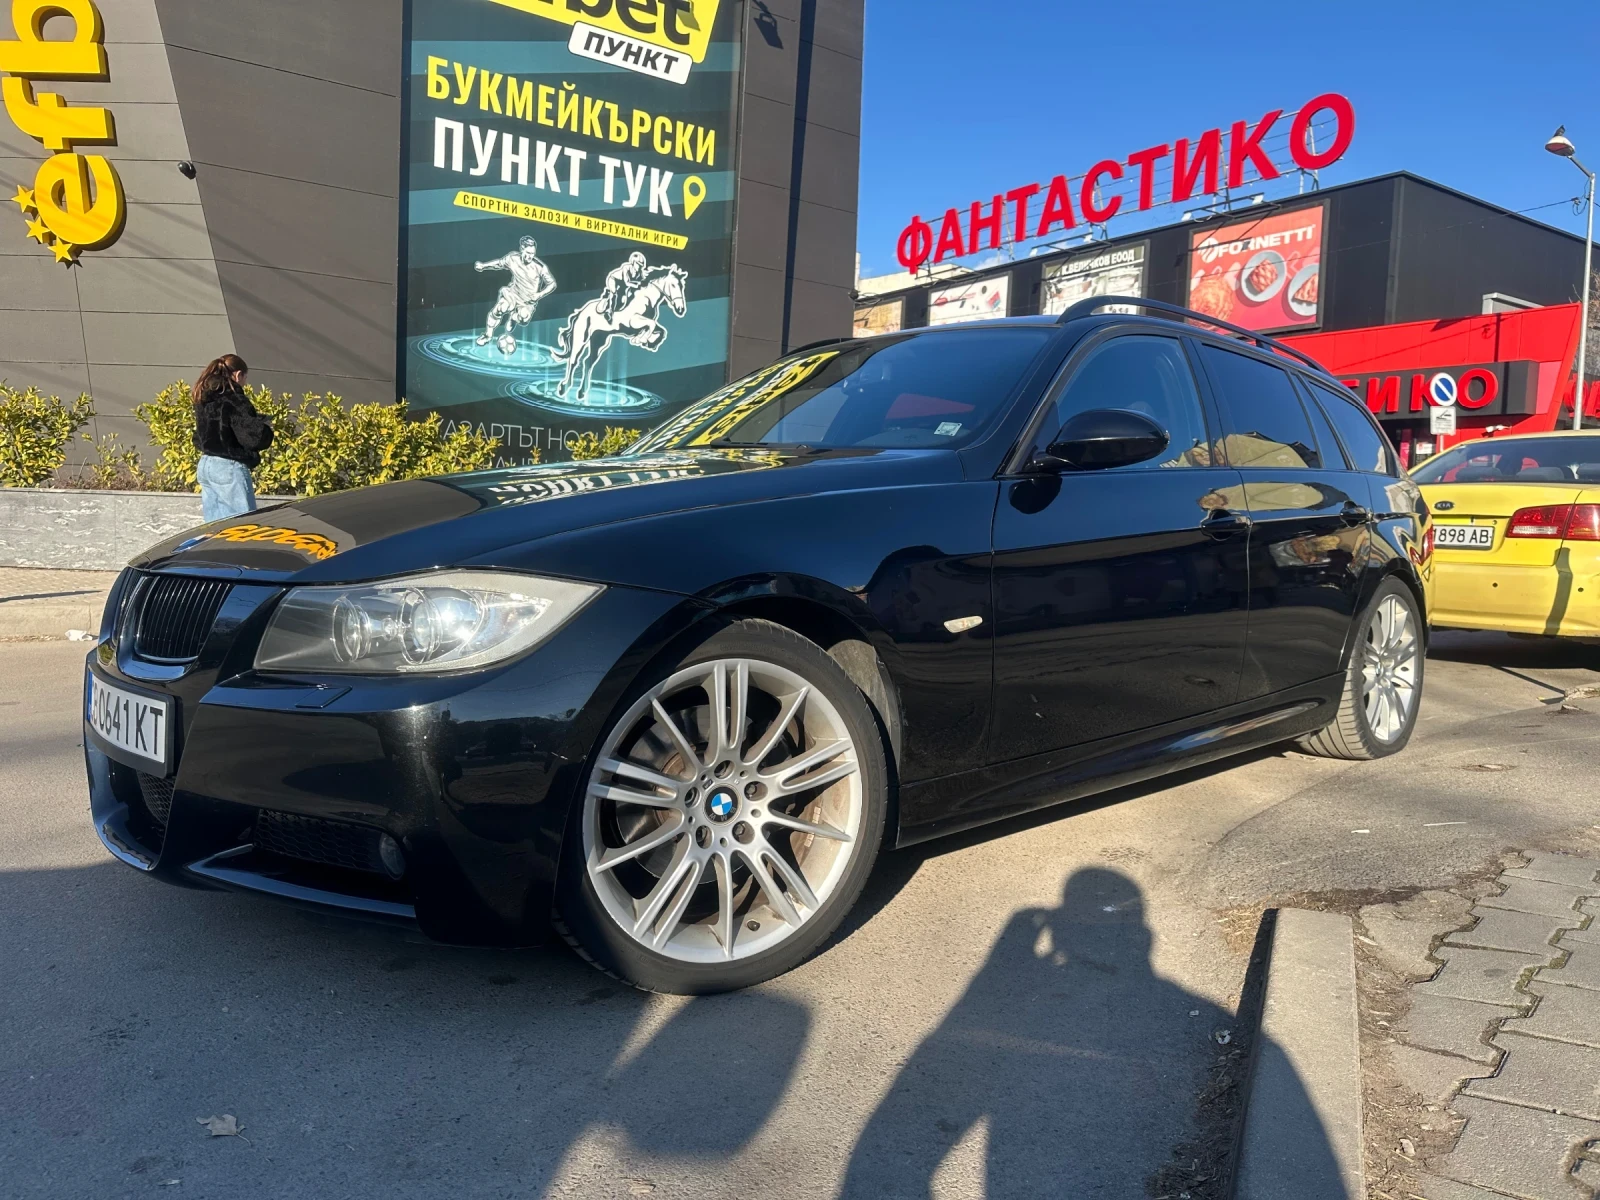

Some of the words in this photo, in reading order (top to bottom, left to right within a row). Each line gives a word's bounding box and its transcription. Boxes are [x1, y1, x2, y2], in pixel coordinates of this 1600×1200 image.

[583, 31, 680, 75] ПУНКТ
[427, 55, 716, 166] БУКМЕЙКЪРСКИ
[433, 116, 587, 197] ПУНКТ
[598, 154, 674, 217] ТУК
[896, 93, 1355, 275] ФАНТАСТИКО
[463, 194, 518, 214] СПОРТНИ
[524, 207, 569, 225] ЗАЛОЗИ
[574, 216, 581, 227] И
[586, 219, 649, 241] ВИРТУАЛНИ
[653, 233, 679, 247] ИГРИ
[1218, 224, 1315, 258] FORNETTI
[1111, 249, 1135, 265] ЕООД
[1469, 530, 1489, 544] AB
[135, 701, 163, 755] KT
